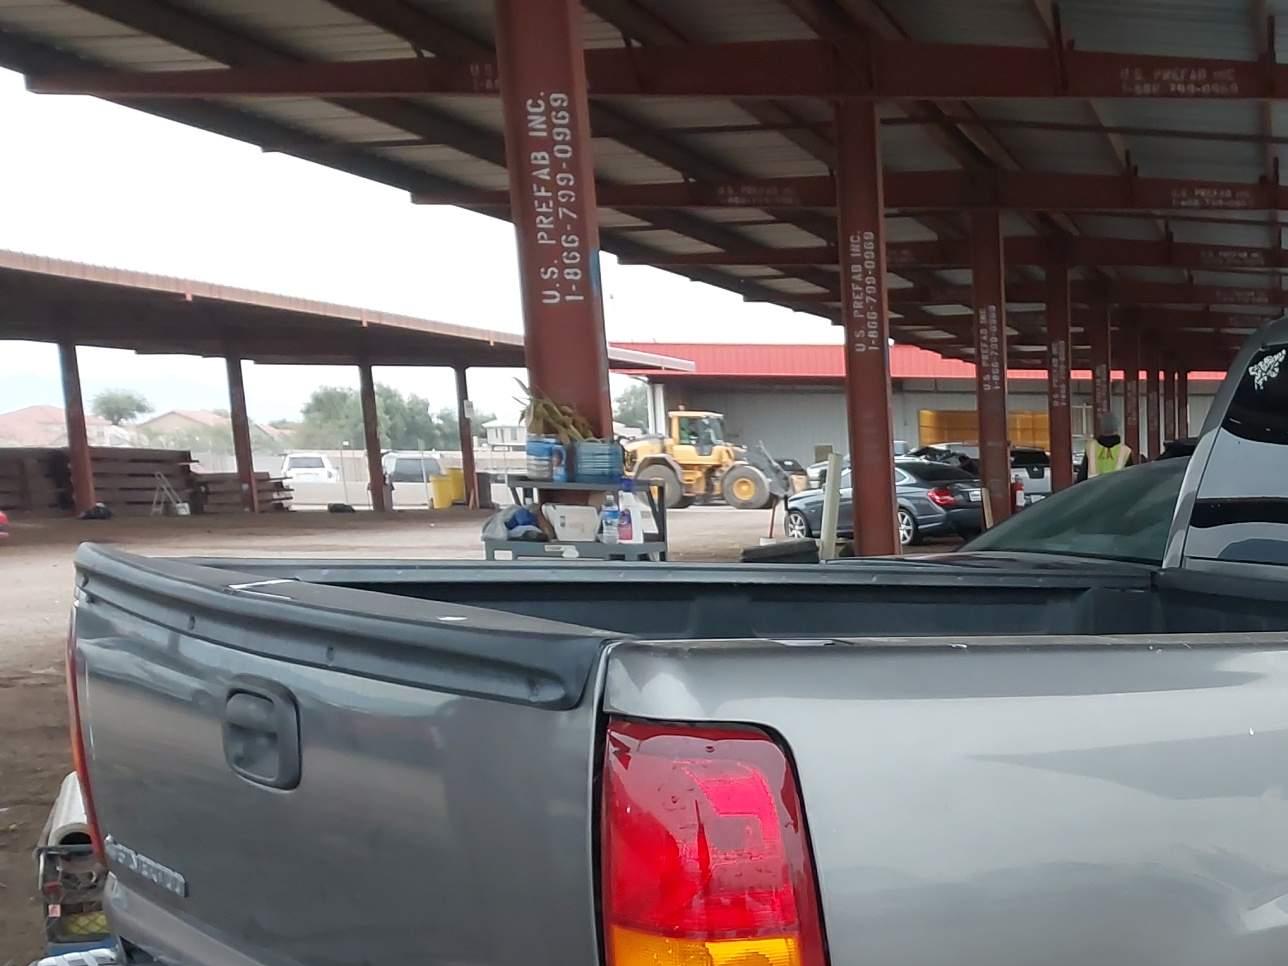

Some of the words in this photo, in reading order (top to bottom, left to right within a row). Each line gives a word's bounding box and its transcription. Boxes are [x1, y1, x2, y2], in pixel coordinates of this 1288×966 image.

[526, 91, 548, 137] INC.
[531, 151, 557, 244] PREFAB
[549, 93, 584, 302] 1-866-799-0969
[540, 259, 560, 304] U.S.
[851, 264, 865, 319] PREFAB
